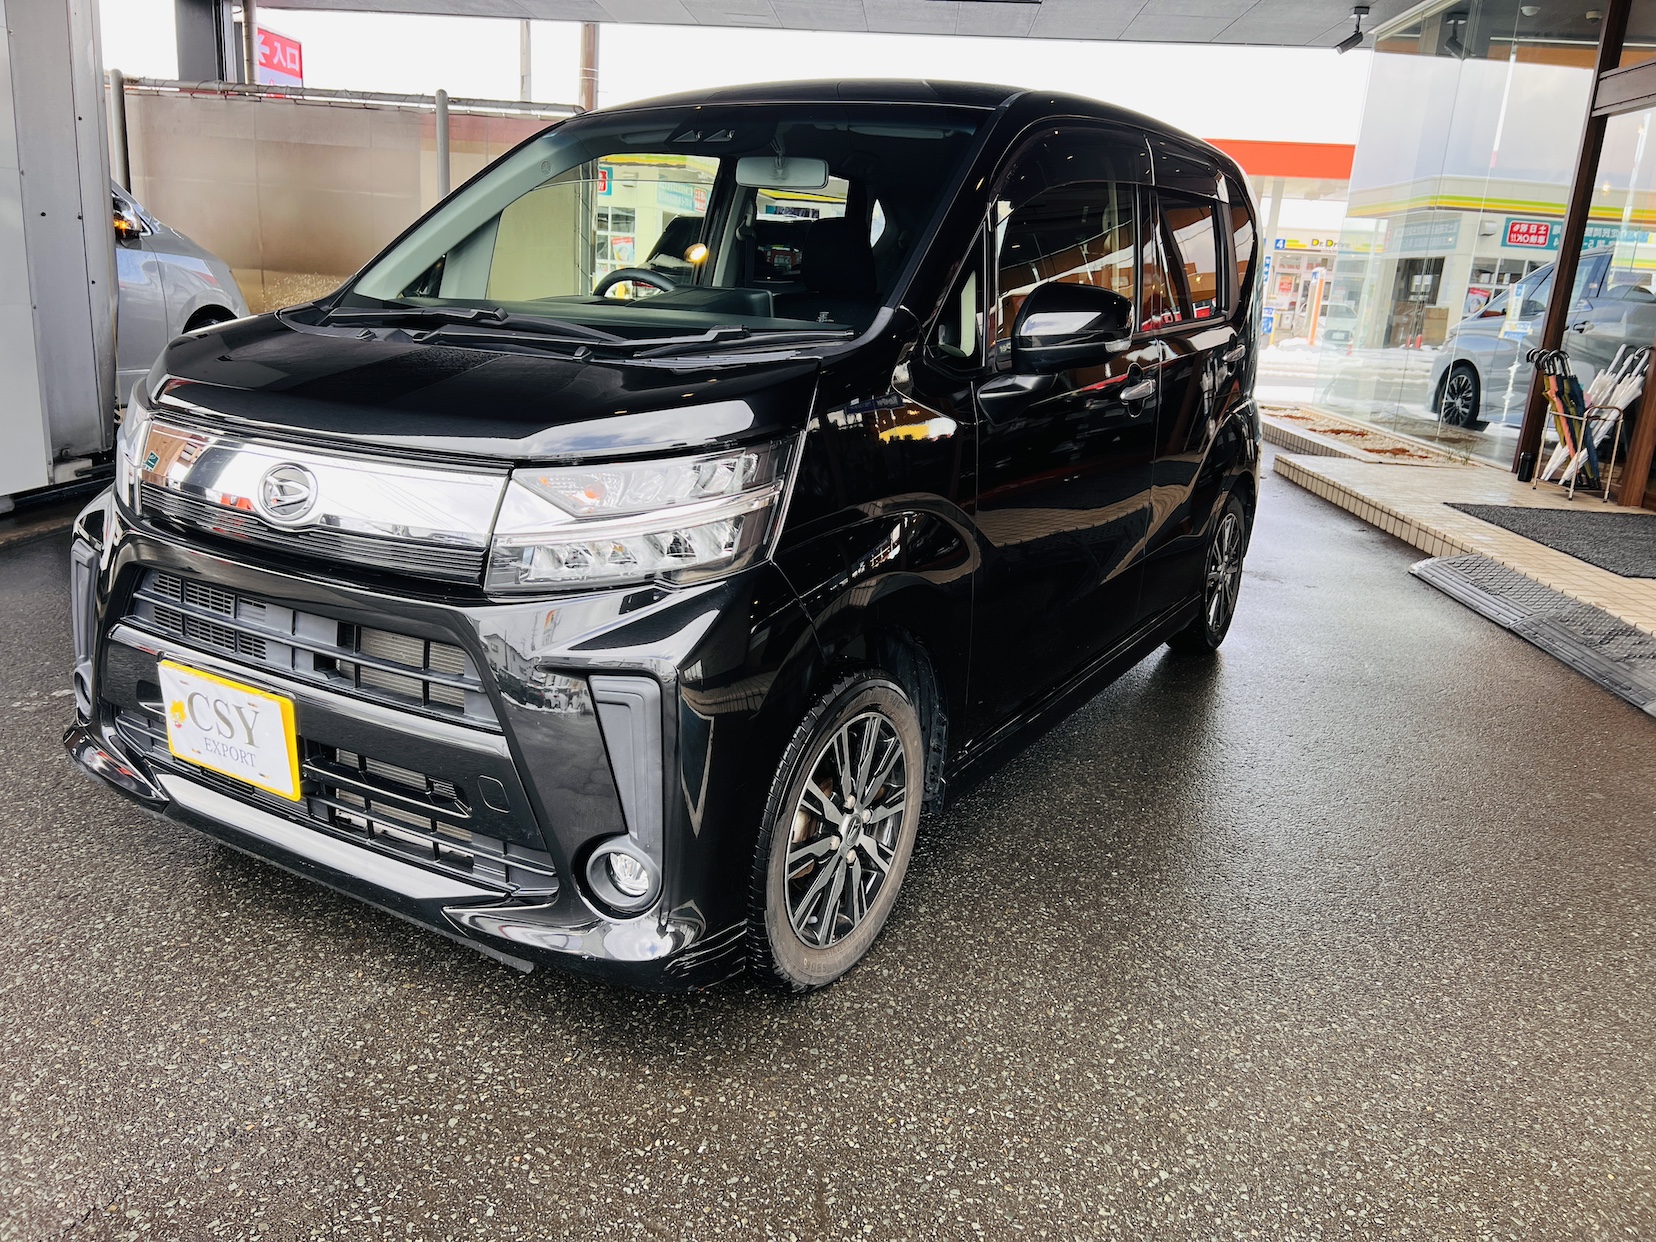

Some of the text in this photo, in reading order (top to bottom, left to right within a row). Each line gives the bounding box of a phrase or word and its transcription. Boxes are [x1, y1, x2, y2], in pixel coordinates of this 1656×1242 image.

[272, 42, 299, 71] 入口
[1276, 239, 1285, 248] 4
[1312, 239, 1324, 247] Dr.
[187, 691, 260, 749] CSY
[204, 737, 256, 768] EXPORT
